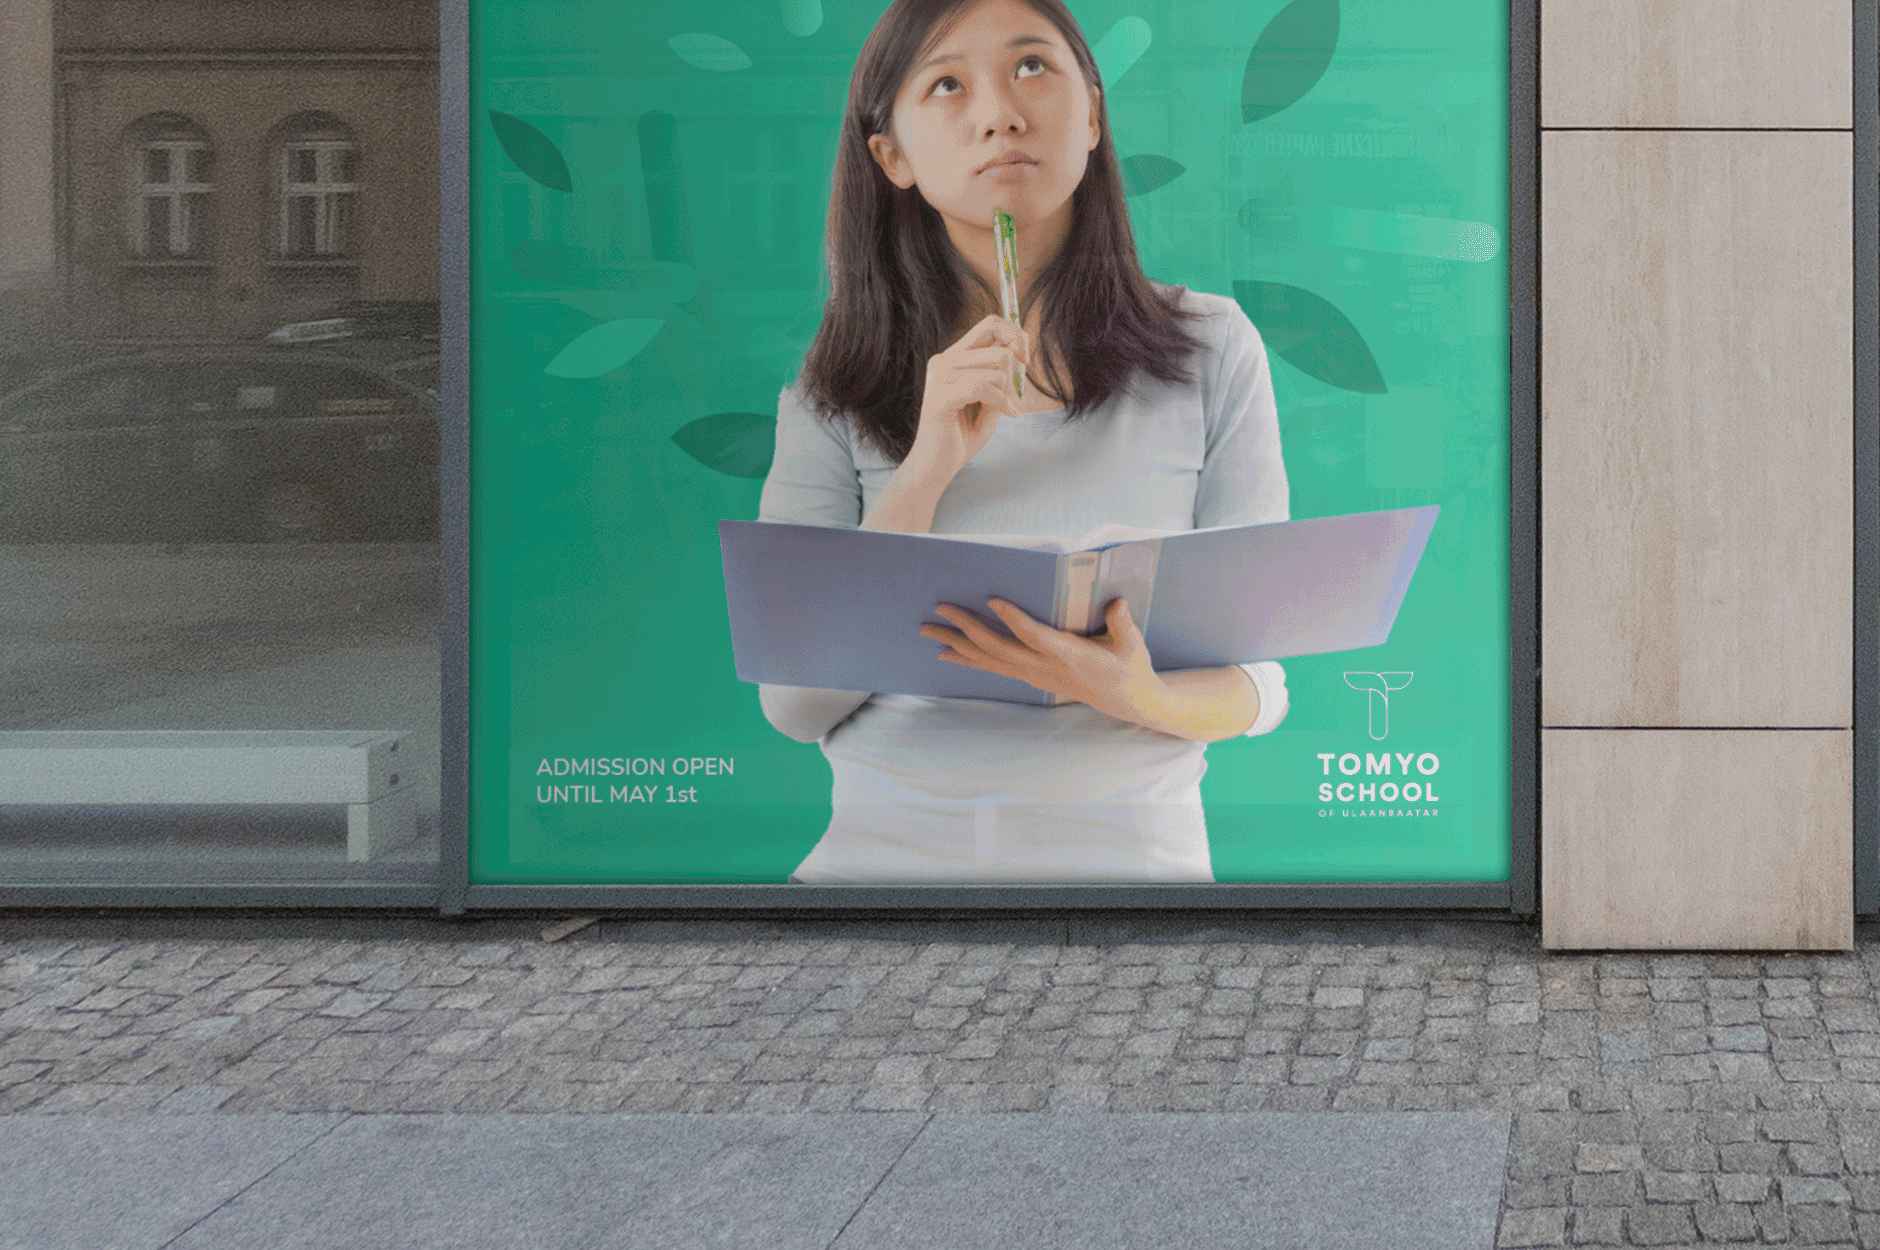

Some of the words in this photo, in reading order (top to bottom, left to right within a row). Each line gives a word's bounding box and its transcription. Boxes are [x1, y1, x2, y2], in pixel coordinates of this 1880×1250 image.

[536, 757, 666, 777] ADMISSION
[672, 757, 735, 777] OPEN
[1316, 752, 1440, 776] TOMYO
[536, 784, 604, 804] UNTIL
[609, 784, 659, 804] MAY
[665, 784, 699, 804] 1st
[1318, 782, 1440, 803] SCHOOL
[1318, 809, 1335, 818] OF
[1342, 809, 1440, 818] ULAANBAATAR
